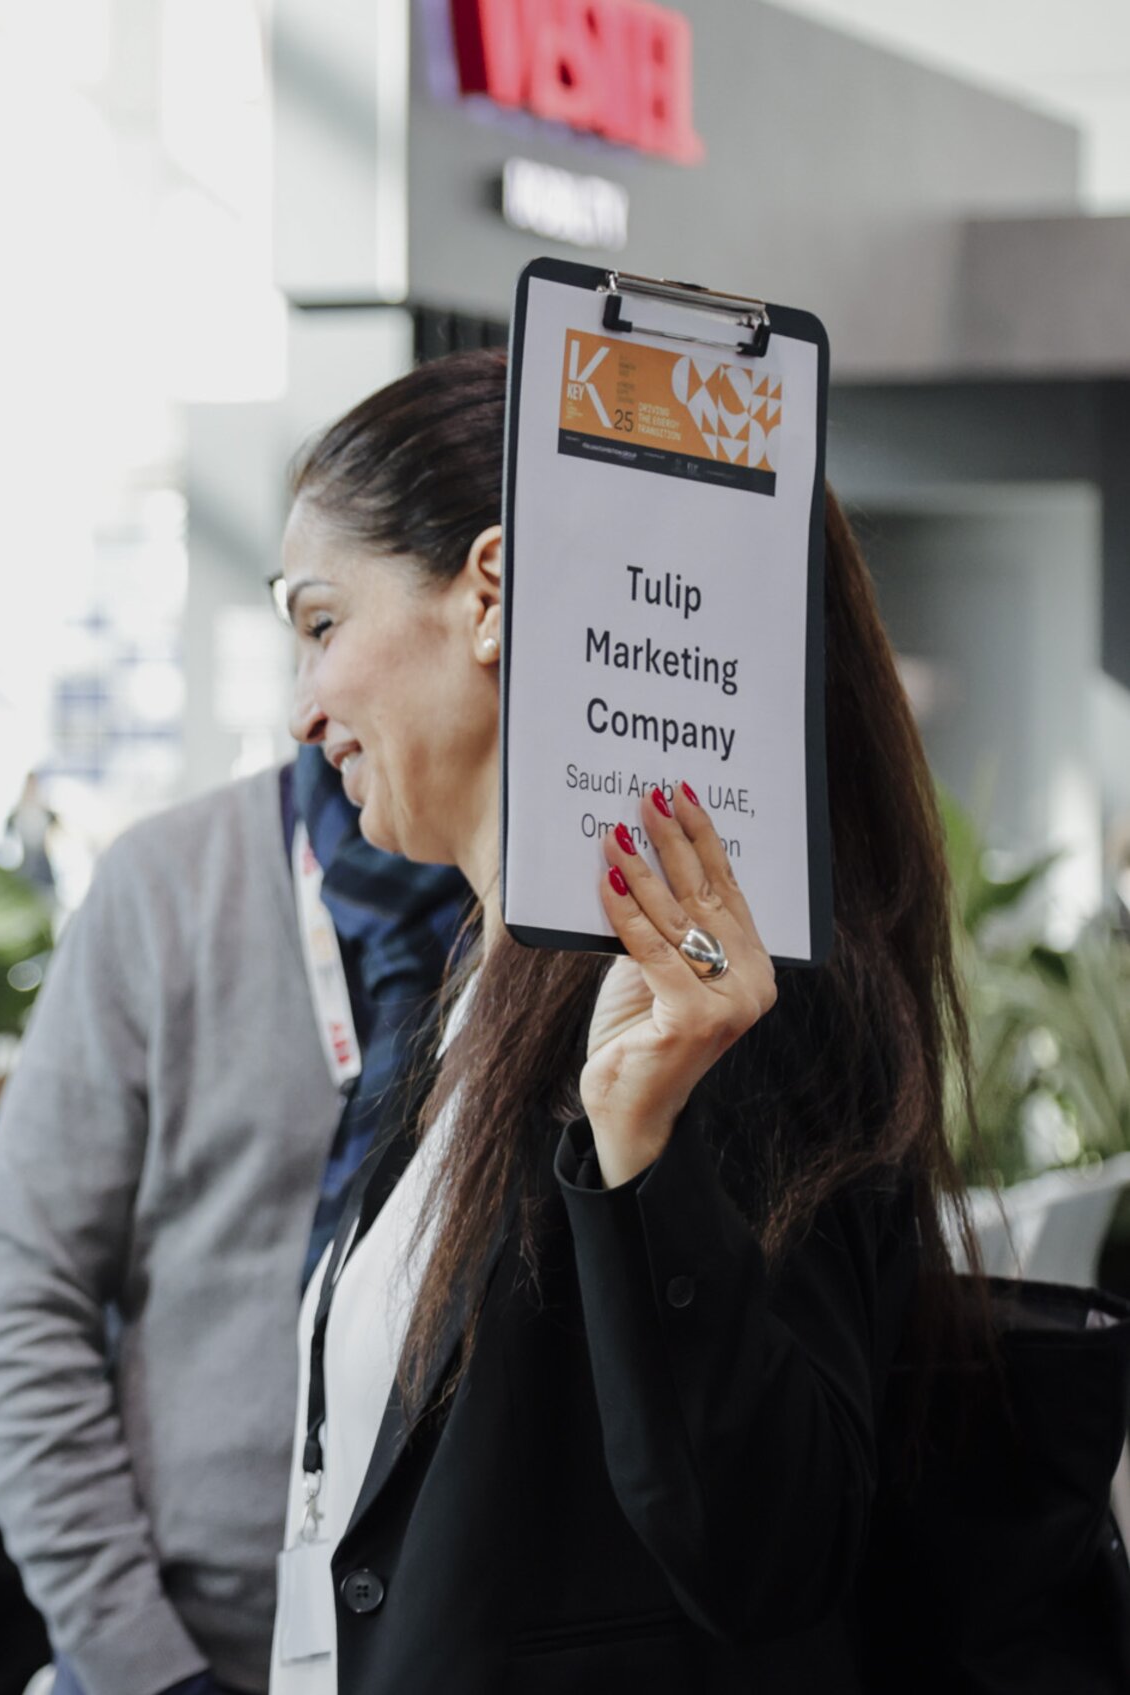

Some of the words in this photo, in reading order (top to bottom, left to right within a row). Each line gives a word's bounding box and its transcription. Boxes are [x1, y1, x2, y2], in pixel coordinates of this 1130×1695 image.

[567, 382, 586, 401] KEY
[614, 409, 634, 432] 25
[627, 565, 702, 619] Tulip
[585, 627, 738, 696] Marketing
[586, 698, 736, 762] Company
[566, 764, 622, 796] Saudi
[628, 773, 679, 802] Arb
[708, 784, 755, 818] UAE,
[581, 813, 648, 849] Omn,
